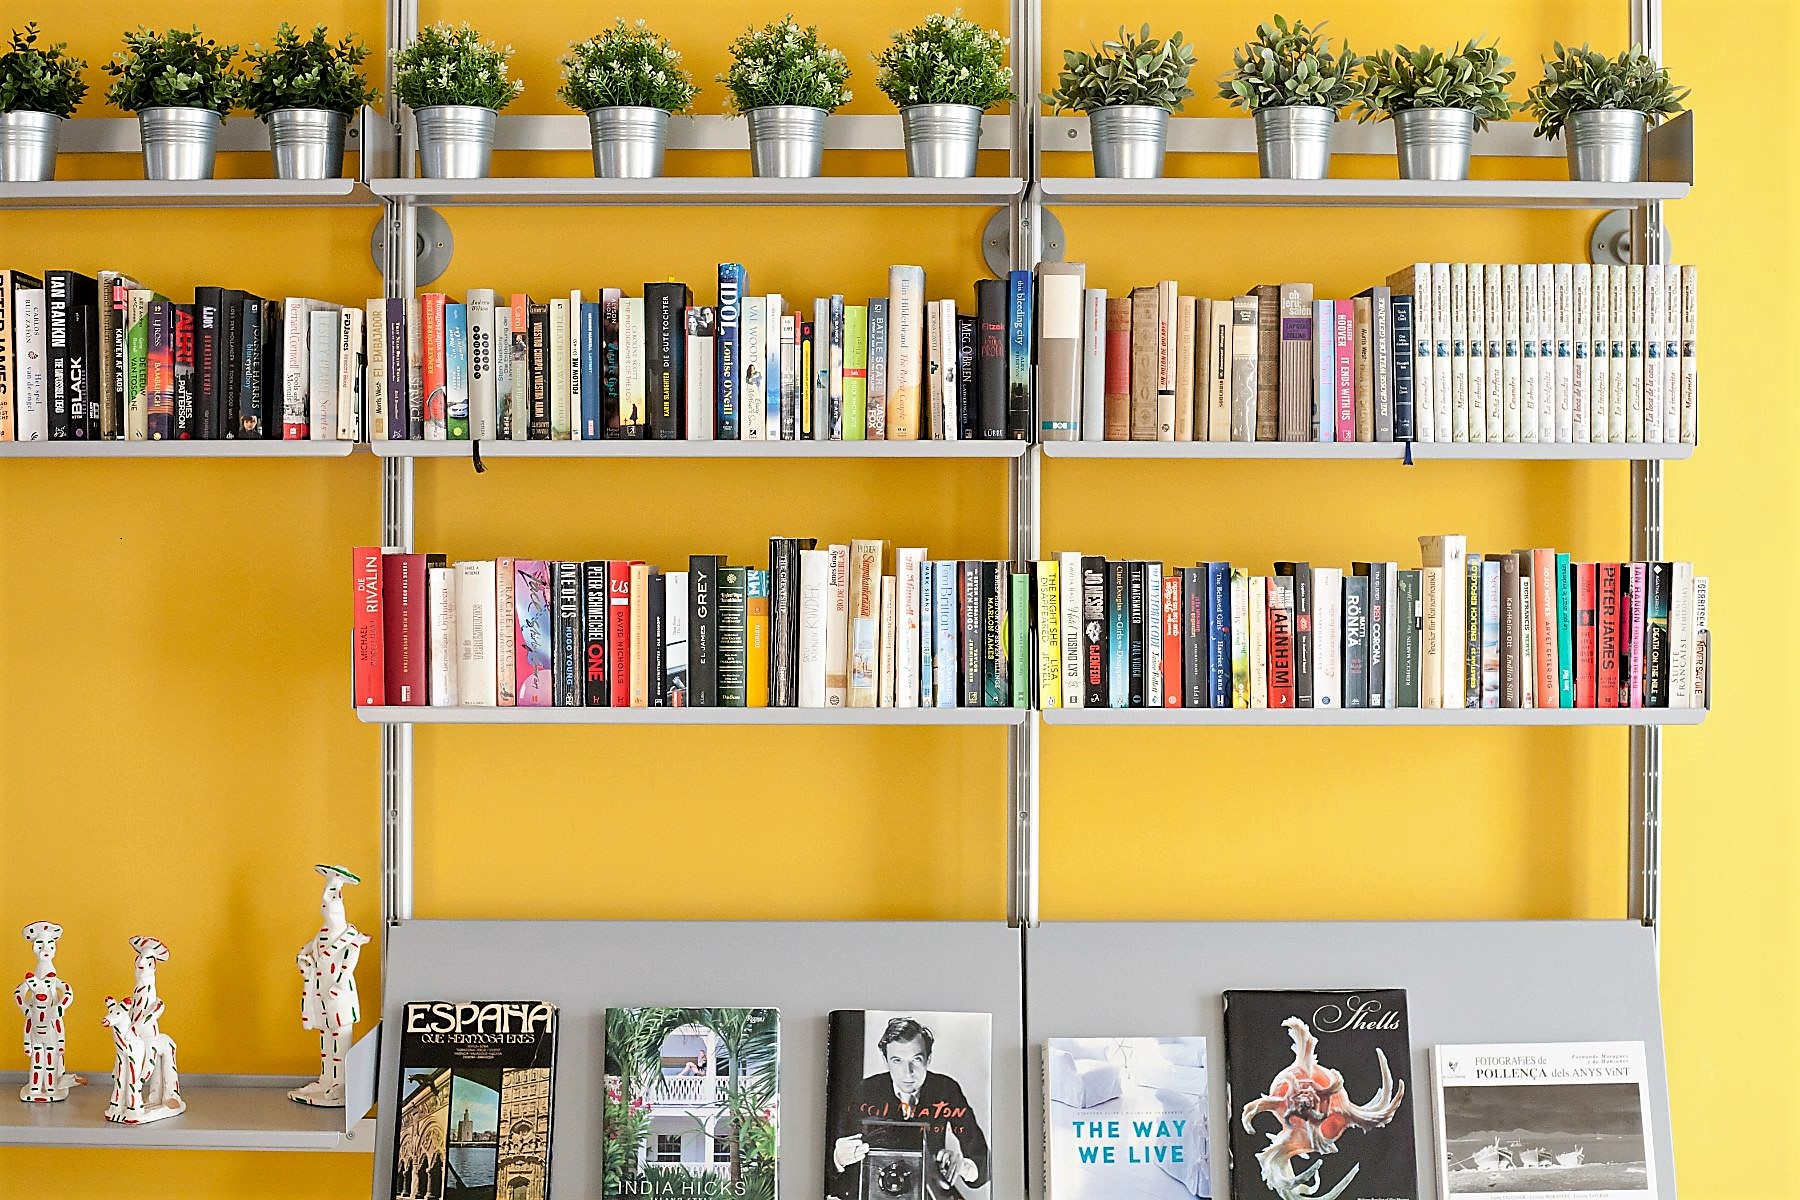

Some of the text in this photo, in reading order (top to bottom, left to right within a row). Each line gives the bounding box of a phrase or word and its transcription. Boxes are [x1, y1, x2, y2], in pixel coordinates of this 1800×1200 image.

[51, 277, 65, 347] IAN RANKIN
[515, 306, 523, 329] Carol
[720, 283, 737, 335] IDOL
[1014, 292, 1024, 328] bleeding
[1378, 297, 1386, 337] GETRÄNKE
[290, 304, 300, 368] Bernard Cornwell
[373, 311, 383, 362] EMBAJADOR
[749, 327, 758, 363] WOOD
[1014, 330, 1024, 346] city
[1337, 314, 1346, 347] HOOVER
[116, 360, 122, 369] AF
[140, 357, 146, 366] DE
[573, 358, 579, 368] ME
[962, 323, 972, 382] MEG O'BRIEN
[54, 358, 64, 413] THE IMPOSSIBLE DEAD
[71, 357, 82, 414] BLACK
[1340, 367, 1350, 386] ENDS
[1575, 378, 1581, 387] la
[1575, 388, 1582, 397] de
[410, 377, 419, 422] SERVICE
[723, 380, 732, 415] O'Neill
[1341, 388, 1350, 408] WITH
[1341, 409, 1350, 421] US
[1574, 412, 1581, 423] La
[830, 550, 838, 568] Grady
[366, 556, 378, 612] RIVALIN
[561, 563, 576, 618] ONE OF US
[611, 580, 628, 594] Us
[697, 570, 708, 618] GREY
[1085, 570, 1103, 584] JO
[588, 566, 603, 642] PETER SCHMEICHEL
[1132, 571, 1141, 624] THE MATCHMAKER
[1697, 583, 1706, 627] GERRITSEN
[995, 625, 1000, 635] OF
[1348, 595, 1361, 648] RÖNKÄ
[1372, 605, 1381, 665] RED CORONA
[1602, 568, 1616, 670] PETER JAMES
[588, 643, 603, 682] ONE
[1089, 645, 1100, 685] GJENFERD
[1652, 651, 1659, 662] ON
[1694, 640, 1704, 694] NEVER SAY DIE
[406, 1003, 553, 1034] ESPAÑA
[1312, 995, 1401, 1033] Shells
[421, 1034, 536, 1043] QUE HERMOSA ERES
[1476, 1068, 1548, 1080] POLLENÇA
[1551, 1069, 1570, 1078] dels
[1572, 1067, 1602, 1078] ANYS
[1072, 1120, 1186, 1138] THE WAY
[1078, 1145, 1184, 1164] WE LIVE
[618, 1181, 747, 1196] INDIA HICKS
